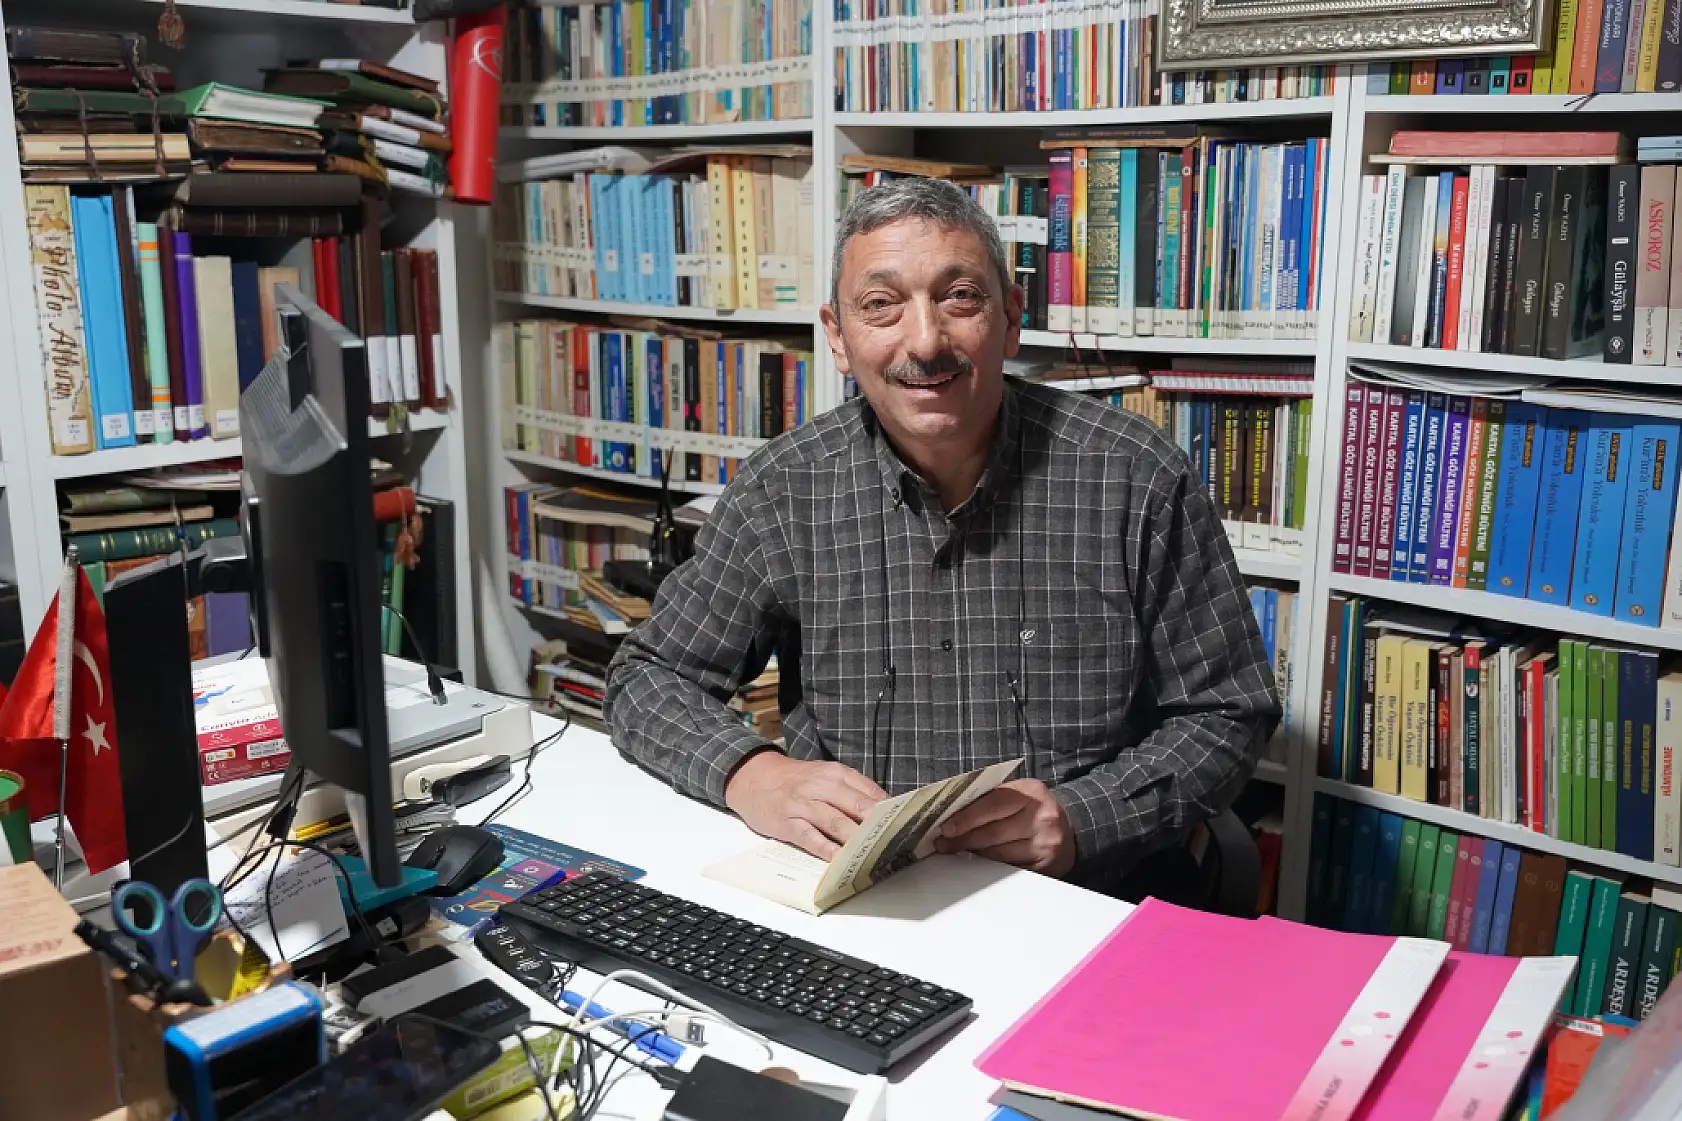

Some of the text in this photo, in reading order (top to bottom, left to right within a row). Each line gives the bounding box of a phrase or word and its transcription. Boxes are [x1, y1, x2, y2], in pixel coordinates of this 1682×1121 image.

[1646, 198, 1665, 272] ASKOROZ
[40, 246, 80, 400] Photo Album
[1339, 407, 1358, 539] KARTAL GÖZ KLİNİĞİ BÜLTENİ
[1359, 409, 1378, 541] KARTAL GÖZ KLİNİĞİ BÜLTENİ
[1379, 411, 1399, 544] KARTAL GÖZ KLİNİĞİ BÜLTENİ
[1398, 414, 1418, 541] KARTAL GÖZ KLİNİĞİ BÜLTENİ
[1418, 416, 1439, 543] KARTAL GÖZ KLİNİĞİ BÜLTENİ
[1439, 422, 1462, 549] KARTAL GÖZ KLİNİĞİ BÜLTENİ
[1468, 457, 1478, 477] GÖZ
[1470, 422, 1481, 456] KARTAL
[1476, 424, 1500, 551] KARTAL GÖZ KLİNİĞİ BÜLTENİ
[1589, 479, 1604, 525] Yolculuk
[1634, 487, 1649, 534] Yolculuk
